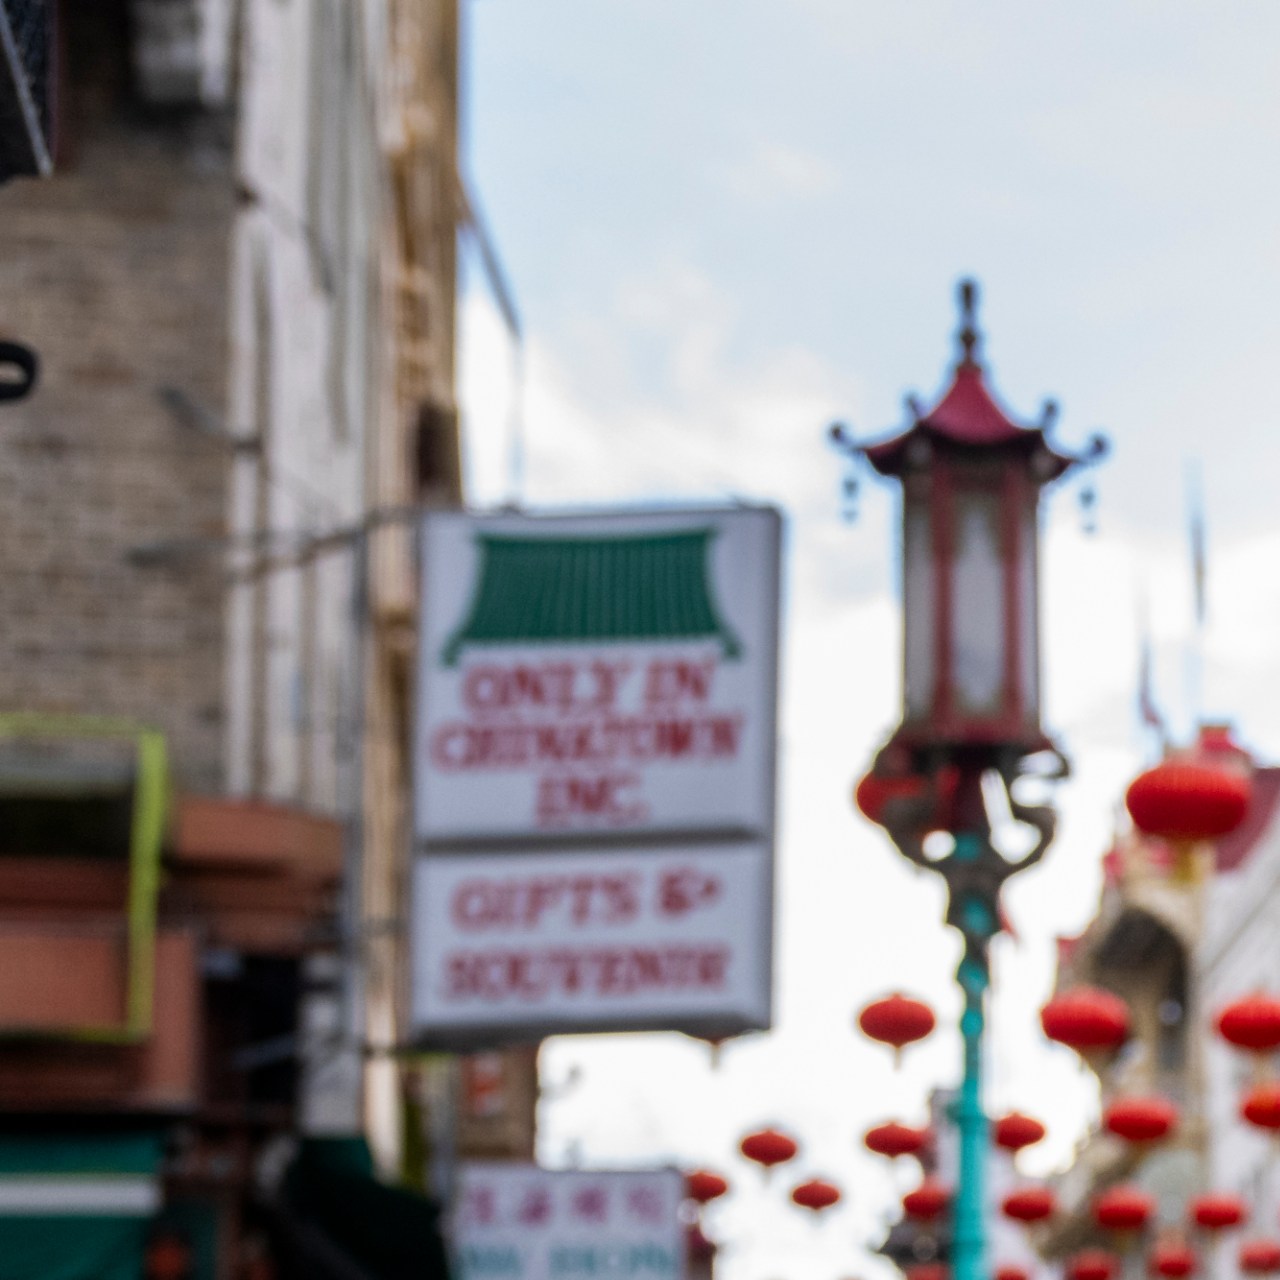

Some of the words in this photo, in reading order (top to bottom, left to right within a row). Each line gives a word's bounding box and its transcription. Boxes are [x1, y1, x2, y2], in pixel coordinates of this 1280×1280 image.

[462, 660, 634, 718] ONLY
[644, 656, 718, 709] IN
[430, 709, 743, 773] CHINATOWN
[451, 870, 643, 932] GIFTS
[440, 944, 731, 1002] SOUVENIR
